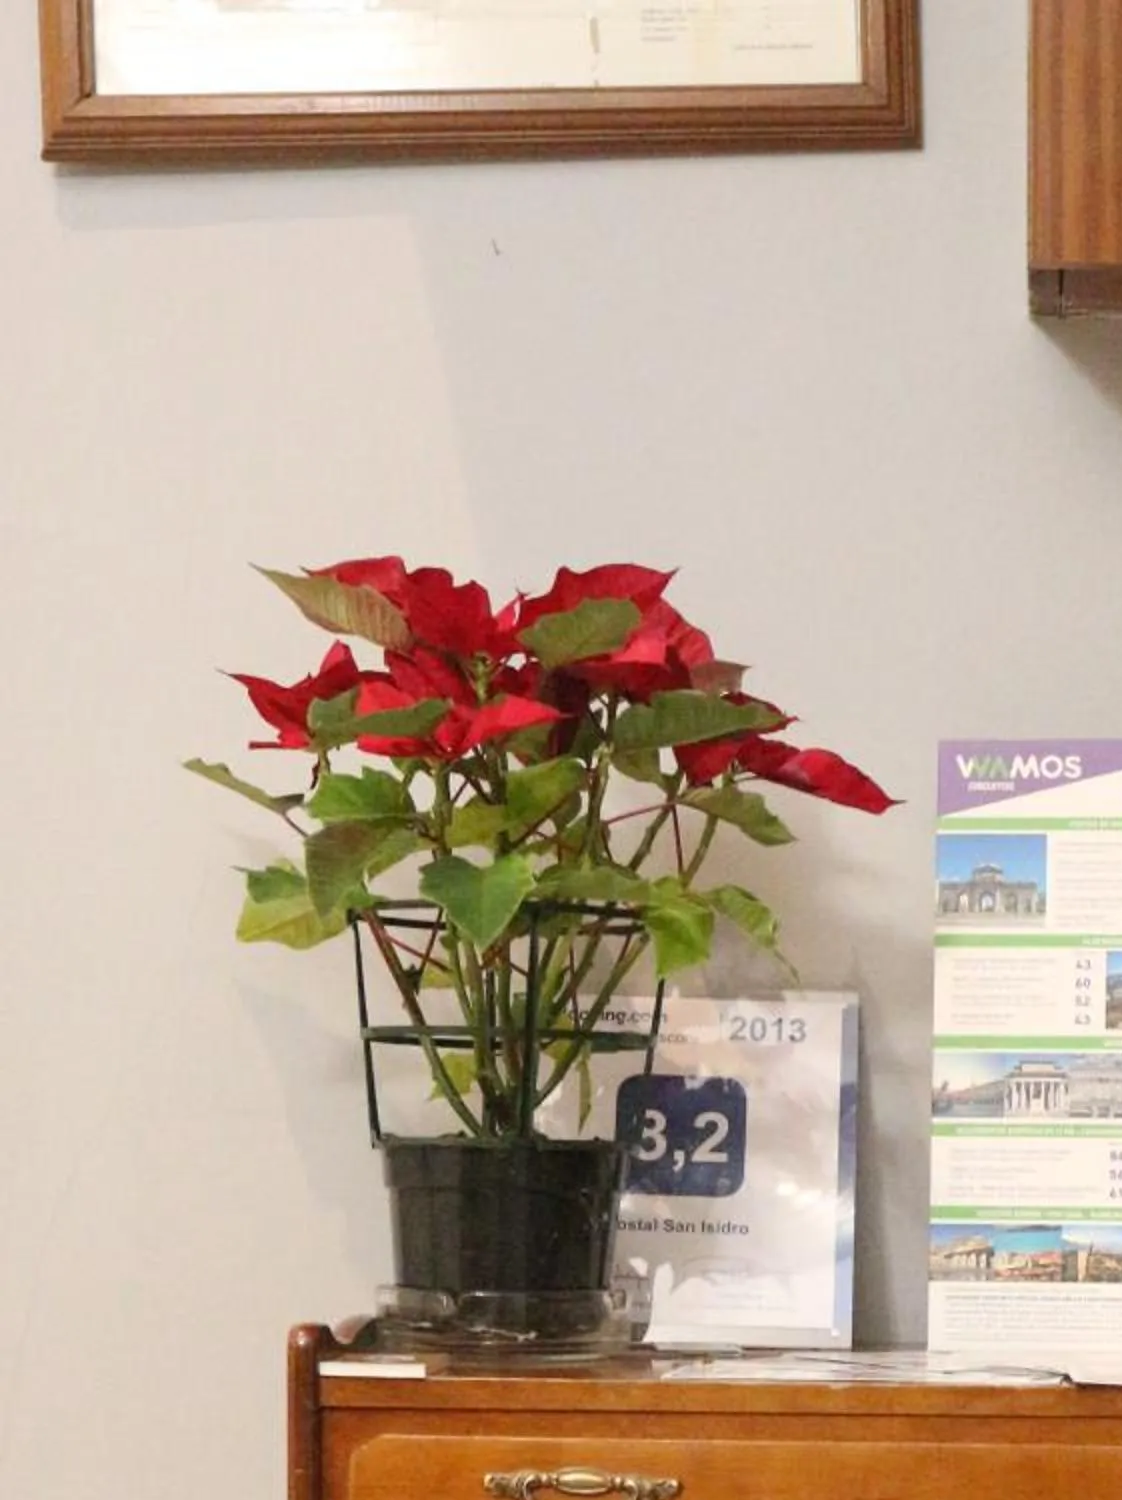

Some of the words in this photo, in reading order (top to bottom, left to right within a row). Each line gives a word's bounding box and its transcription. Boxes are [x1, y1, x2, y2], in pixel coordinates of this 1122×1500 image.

[956, 753, 1082, 779] WAMOS
[729, 1016, 807, 1043] 2013
[663, 1217, 695, 1233] San
[701, 1219, 750, 1235] Isidro
